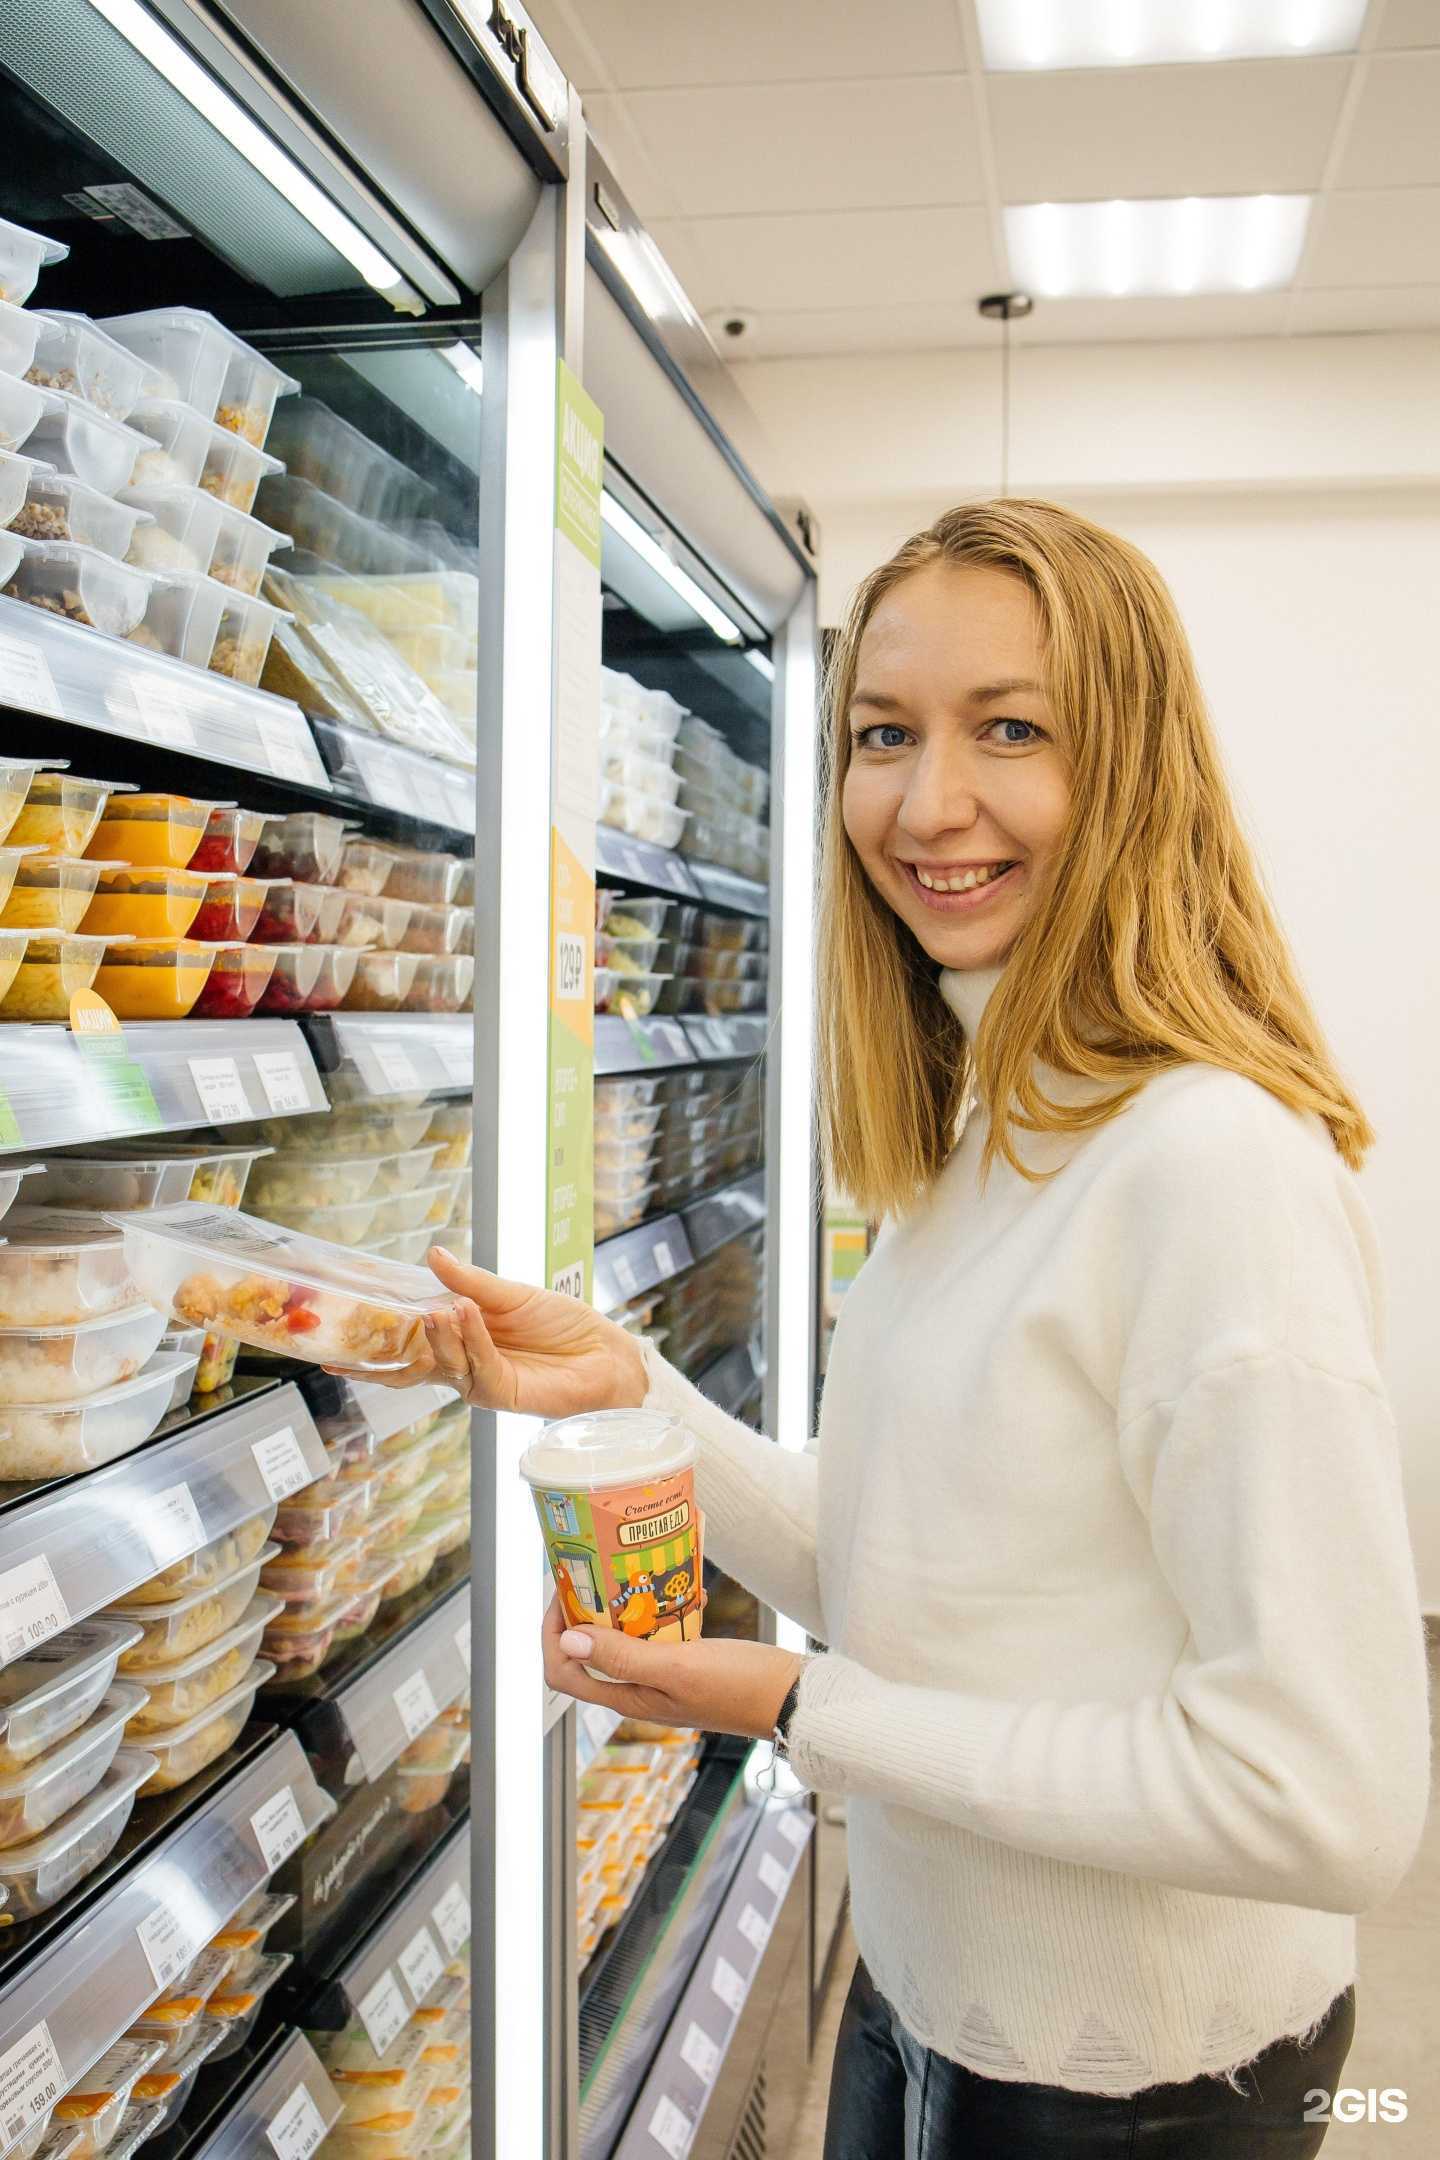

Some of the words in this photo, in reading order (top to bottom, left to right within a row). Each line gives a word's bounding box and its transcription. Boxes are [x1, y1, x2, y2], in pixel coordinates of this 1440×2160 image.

[629, 1517, 668, 1541] ПРОСТАЯ
[669, 1509, 684, 1530] ЕДА
[29, 2081, 57, 2115] 159.00
